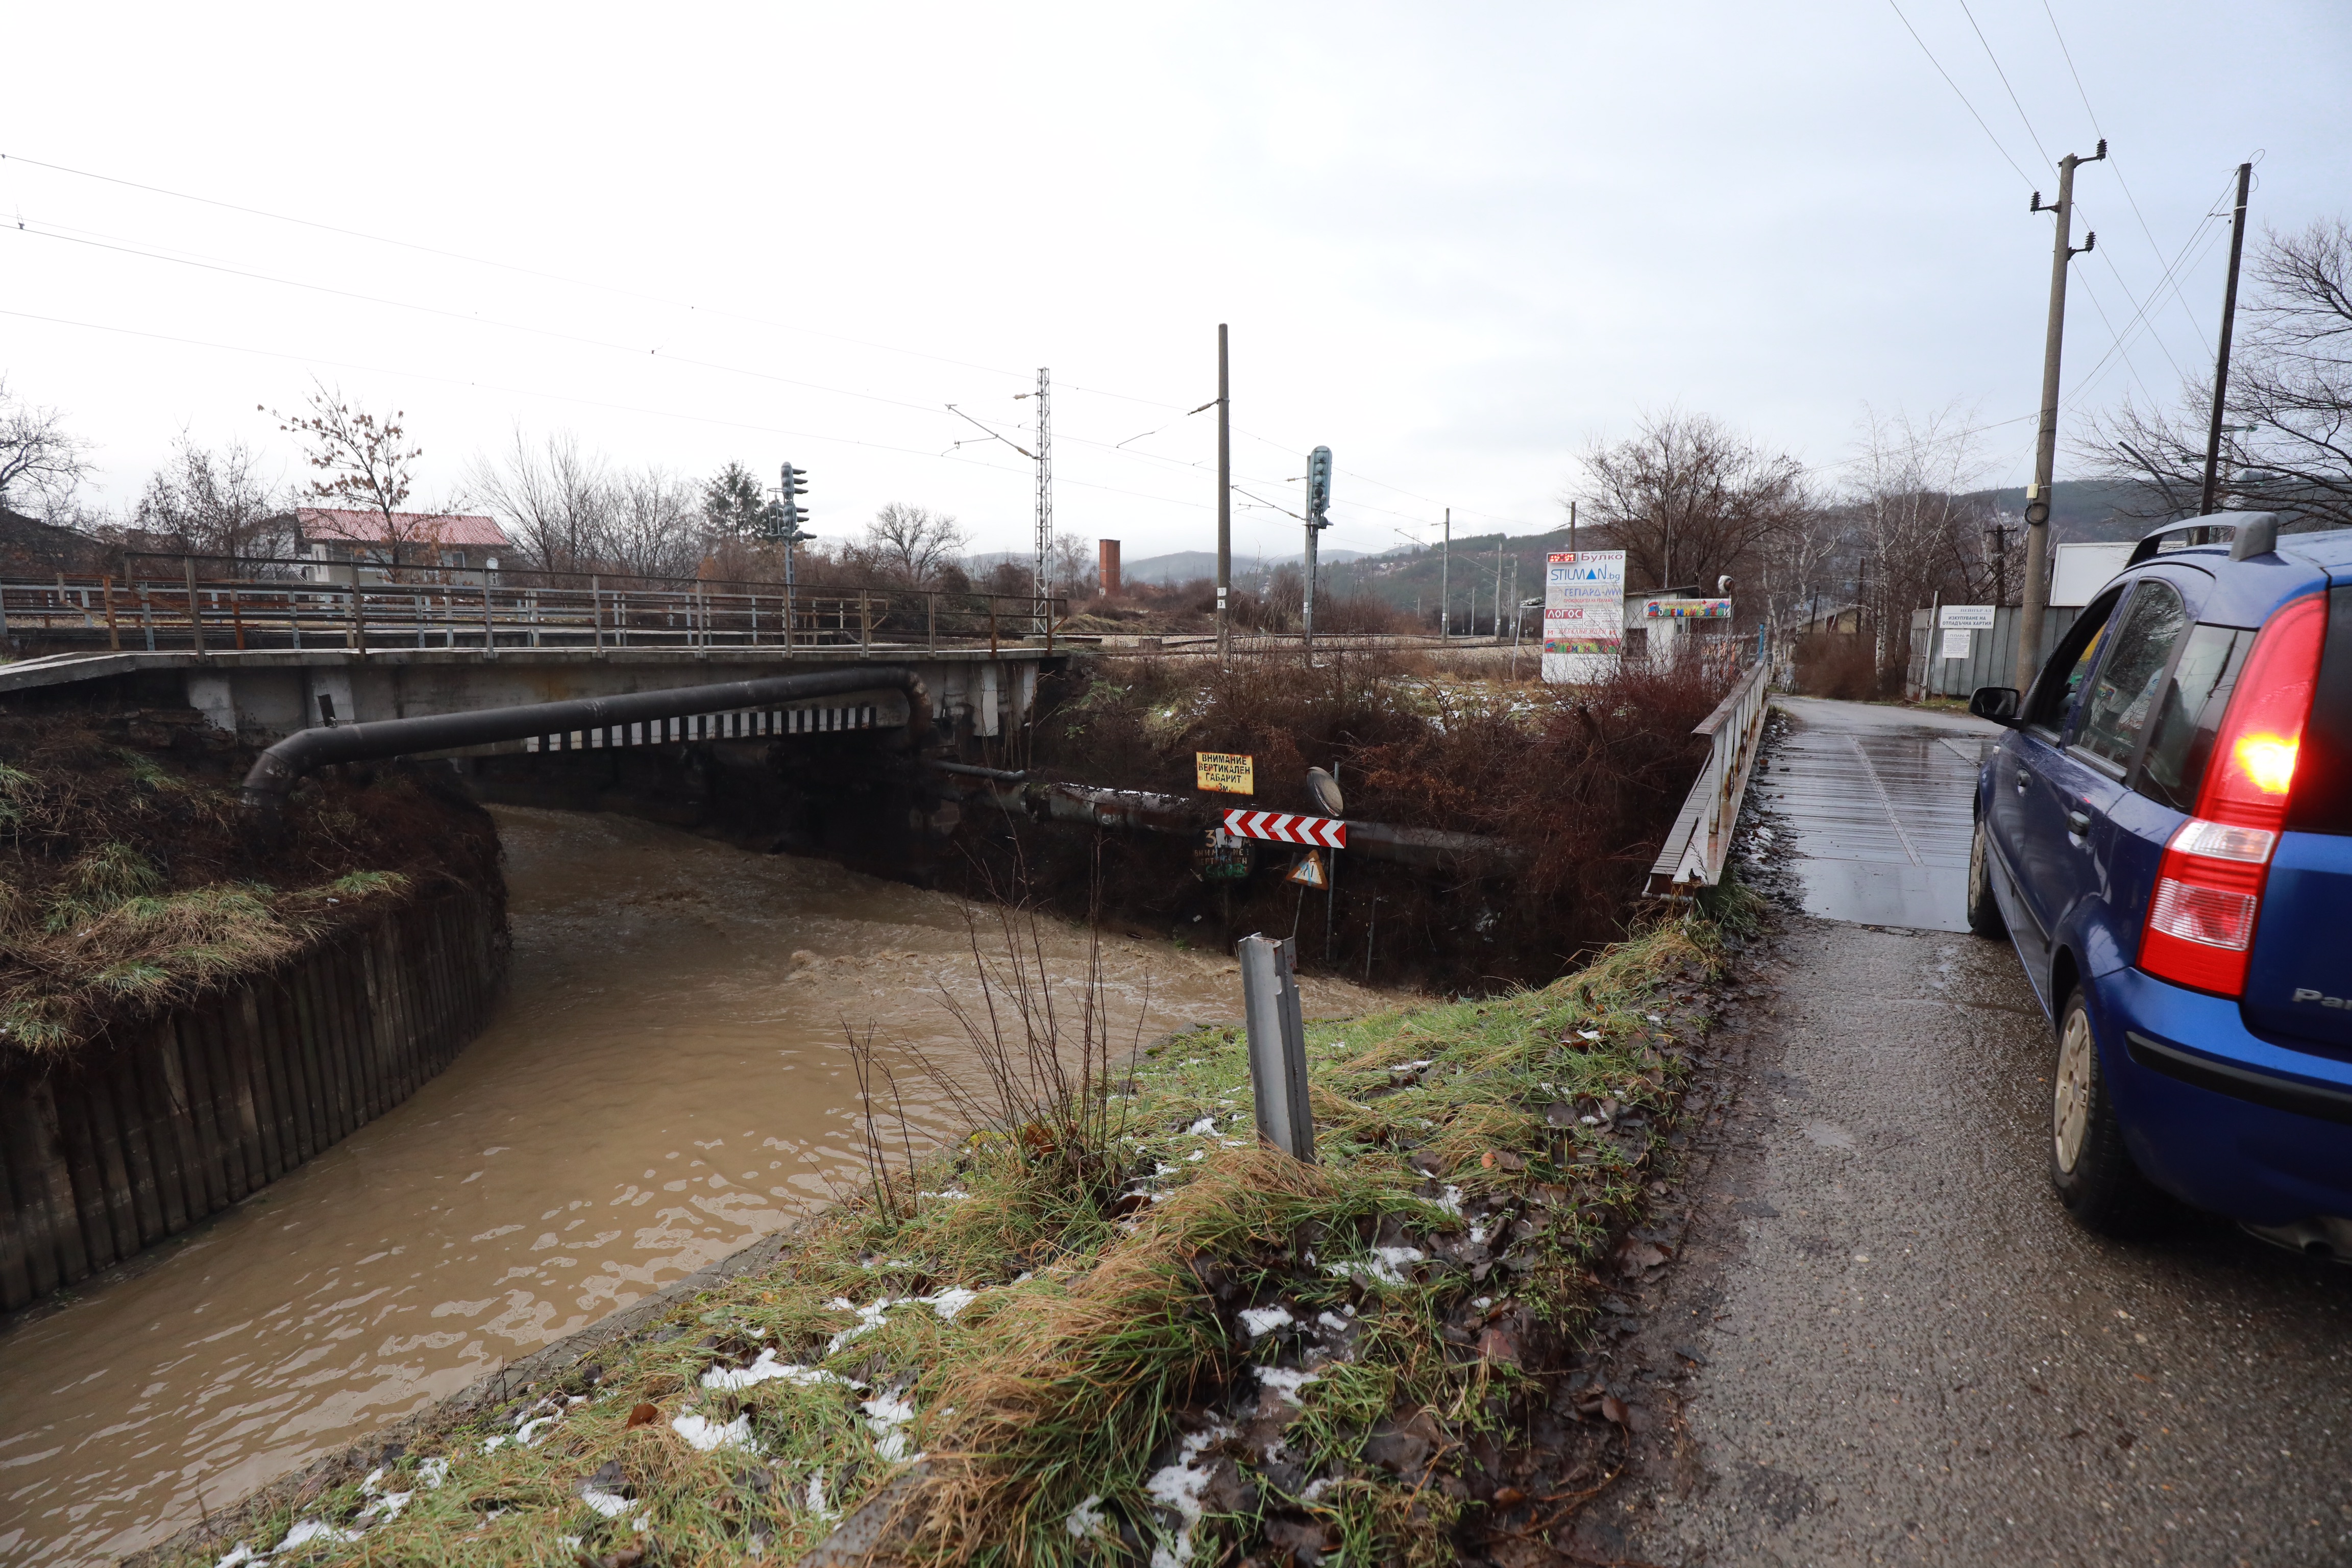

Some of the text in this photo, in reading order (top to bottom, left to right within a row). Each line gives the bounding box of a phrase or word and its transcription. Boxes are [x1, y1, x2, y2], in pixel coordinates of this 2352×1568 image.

[1581, 552, 1623, 562] Булко
[1548, 609, 1582, 618] ЛОГОС
[1202, 753, 1247, 765] ВНИМАНИЕ
[1198, 763, 1251, 775] ВЕРТИКАЛЕН
[1206, 772, 1241, 783] ГАБАРИТ
[1218, 782, 1231, 792] 3м.
